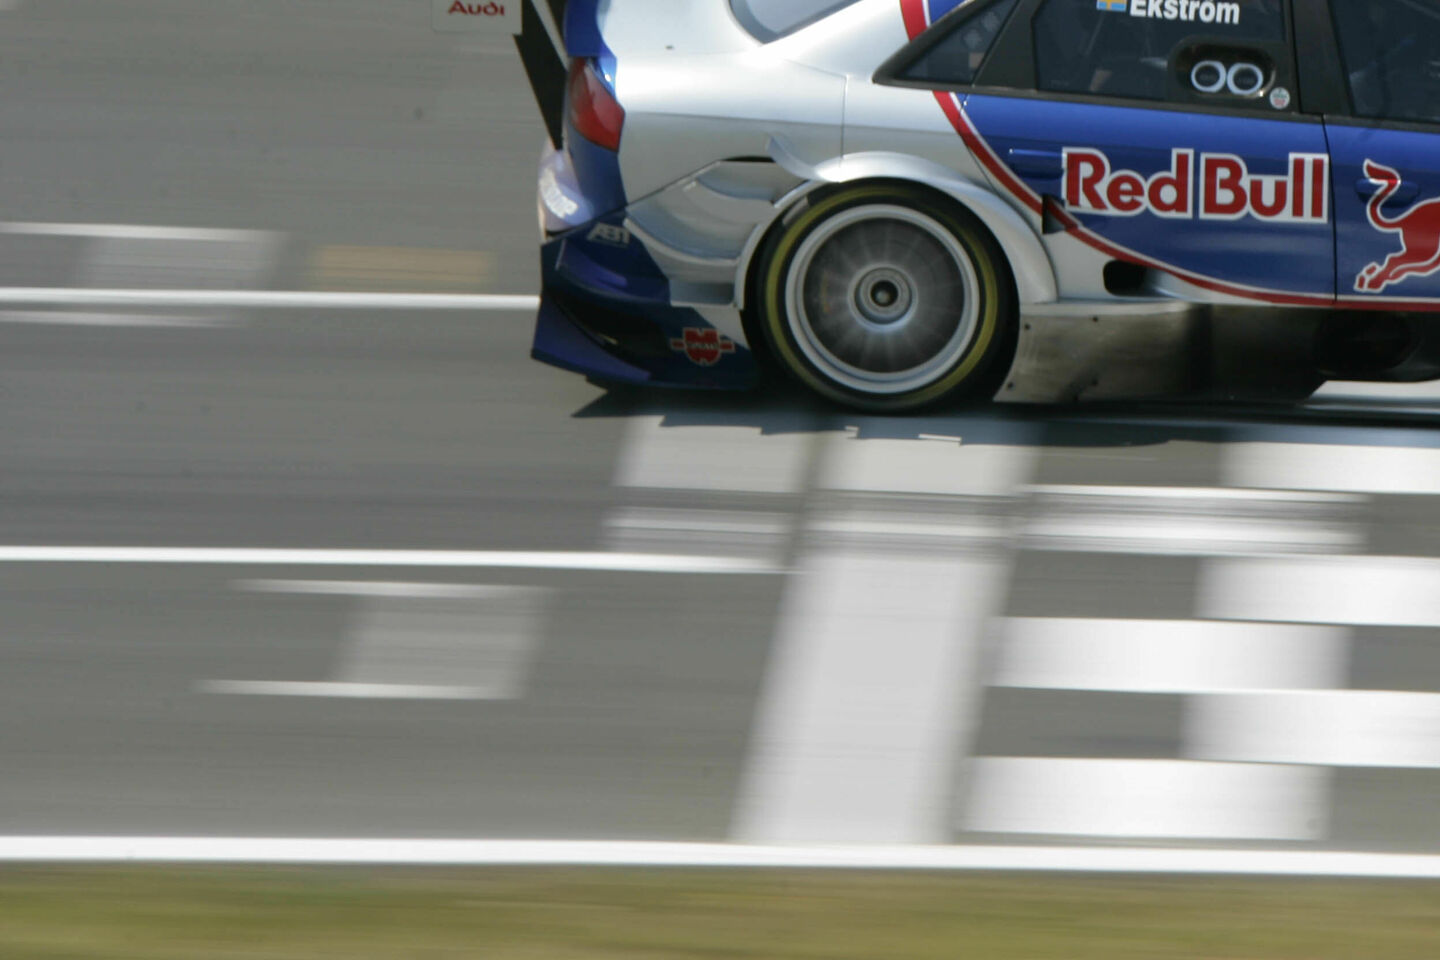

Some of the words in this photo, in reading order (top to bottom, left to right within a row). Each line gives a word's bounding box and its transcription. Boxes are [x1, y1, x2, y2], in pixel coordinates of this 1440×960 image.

[448, 0, 505, 17] Audi
[1063, 148, 1192, 217] Red
[1201, 154, 1327, 221] Bull
